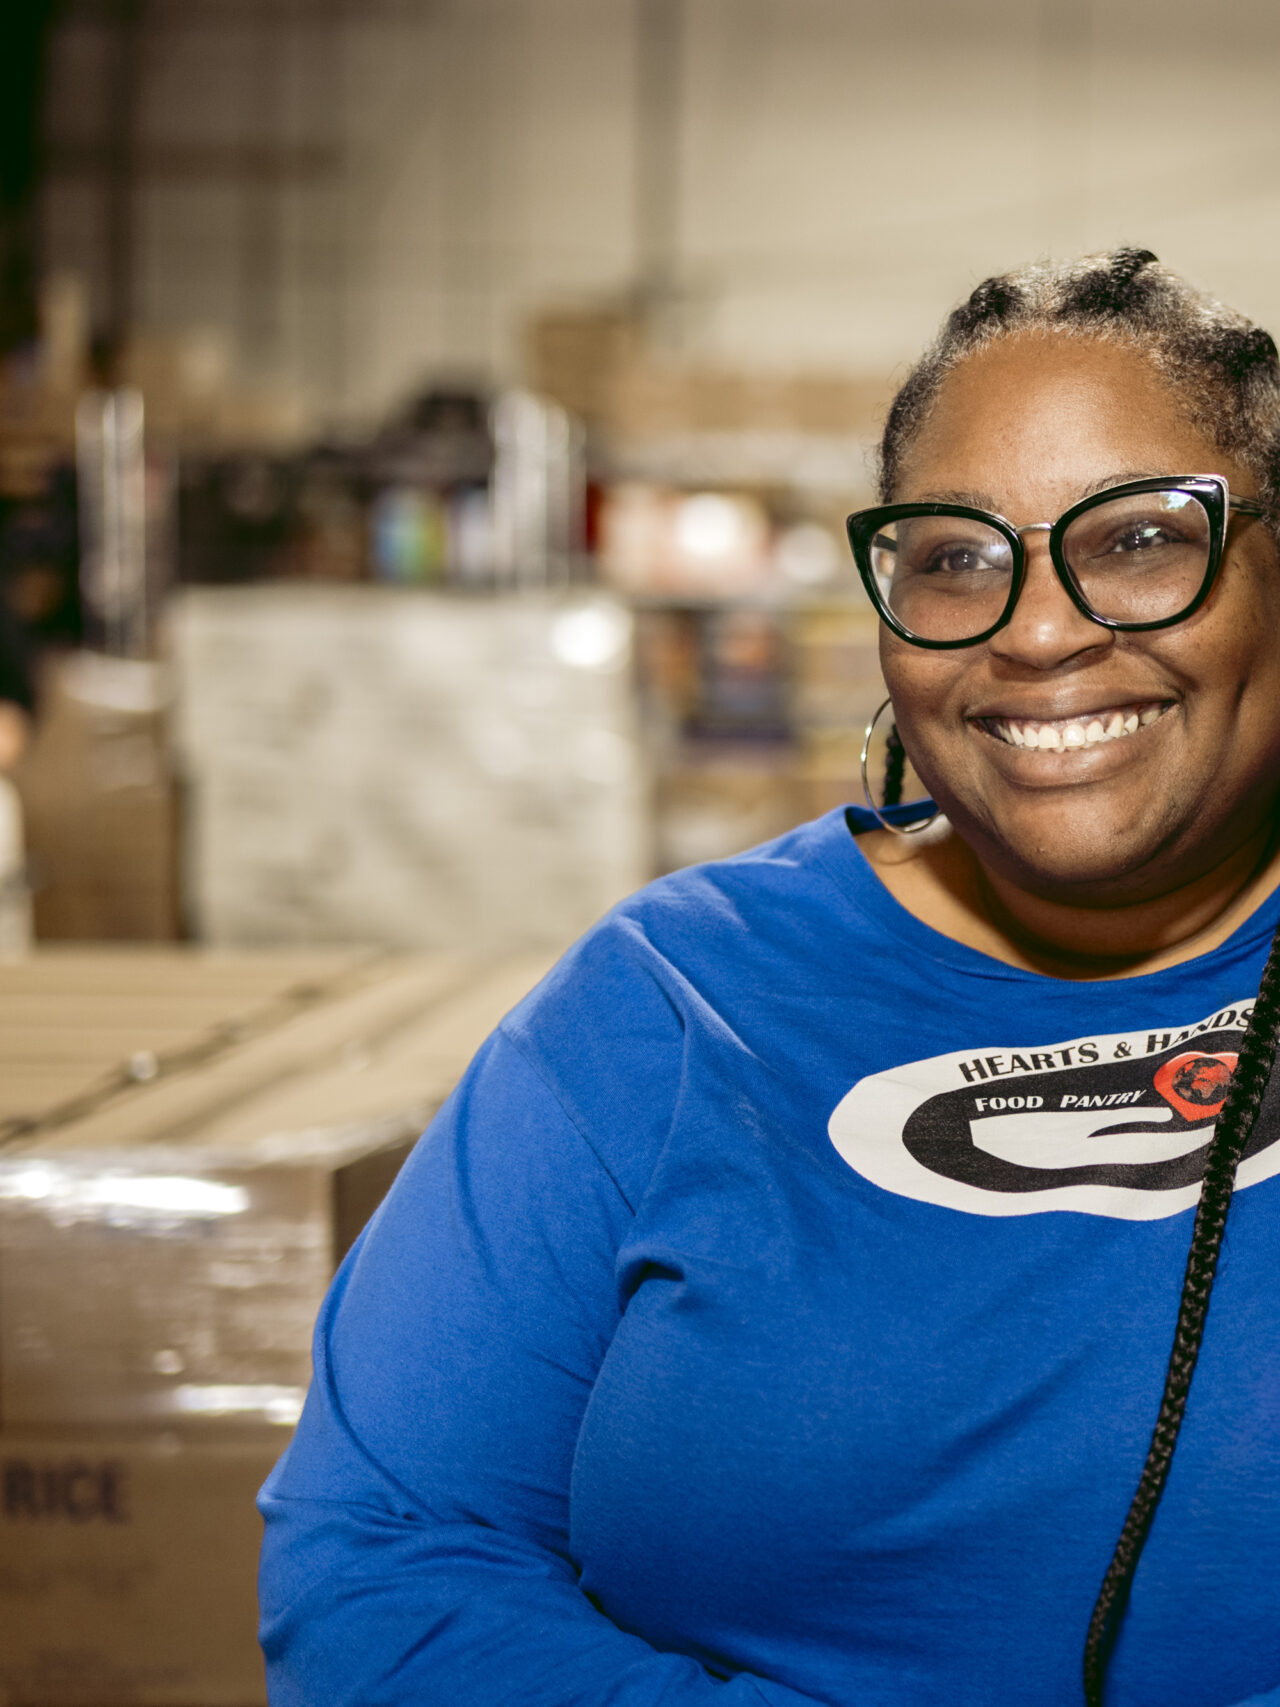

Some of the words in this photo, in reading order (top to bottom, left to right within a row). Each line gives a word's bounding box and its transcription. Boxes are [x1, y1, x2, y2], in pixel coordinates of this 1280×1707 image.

[958, 1042, 1099, 1083] HEARTS
[1113, 1041, 1132, 1059] &
[1146, 1007, 1257, 1053] HANDS
[975, 1095, 1044, 1112] FOOD
[1059, 1089, 1147, 1109] PANTRY
